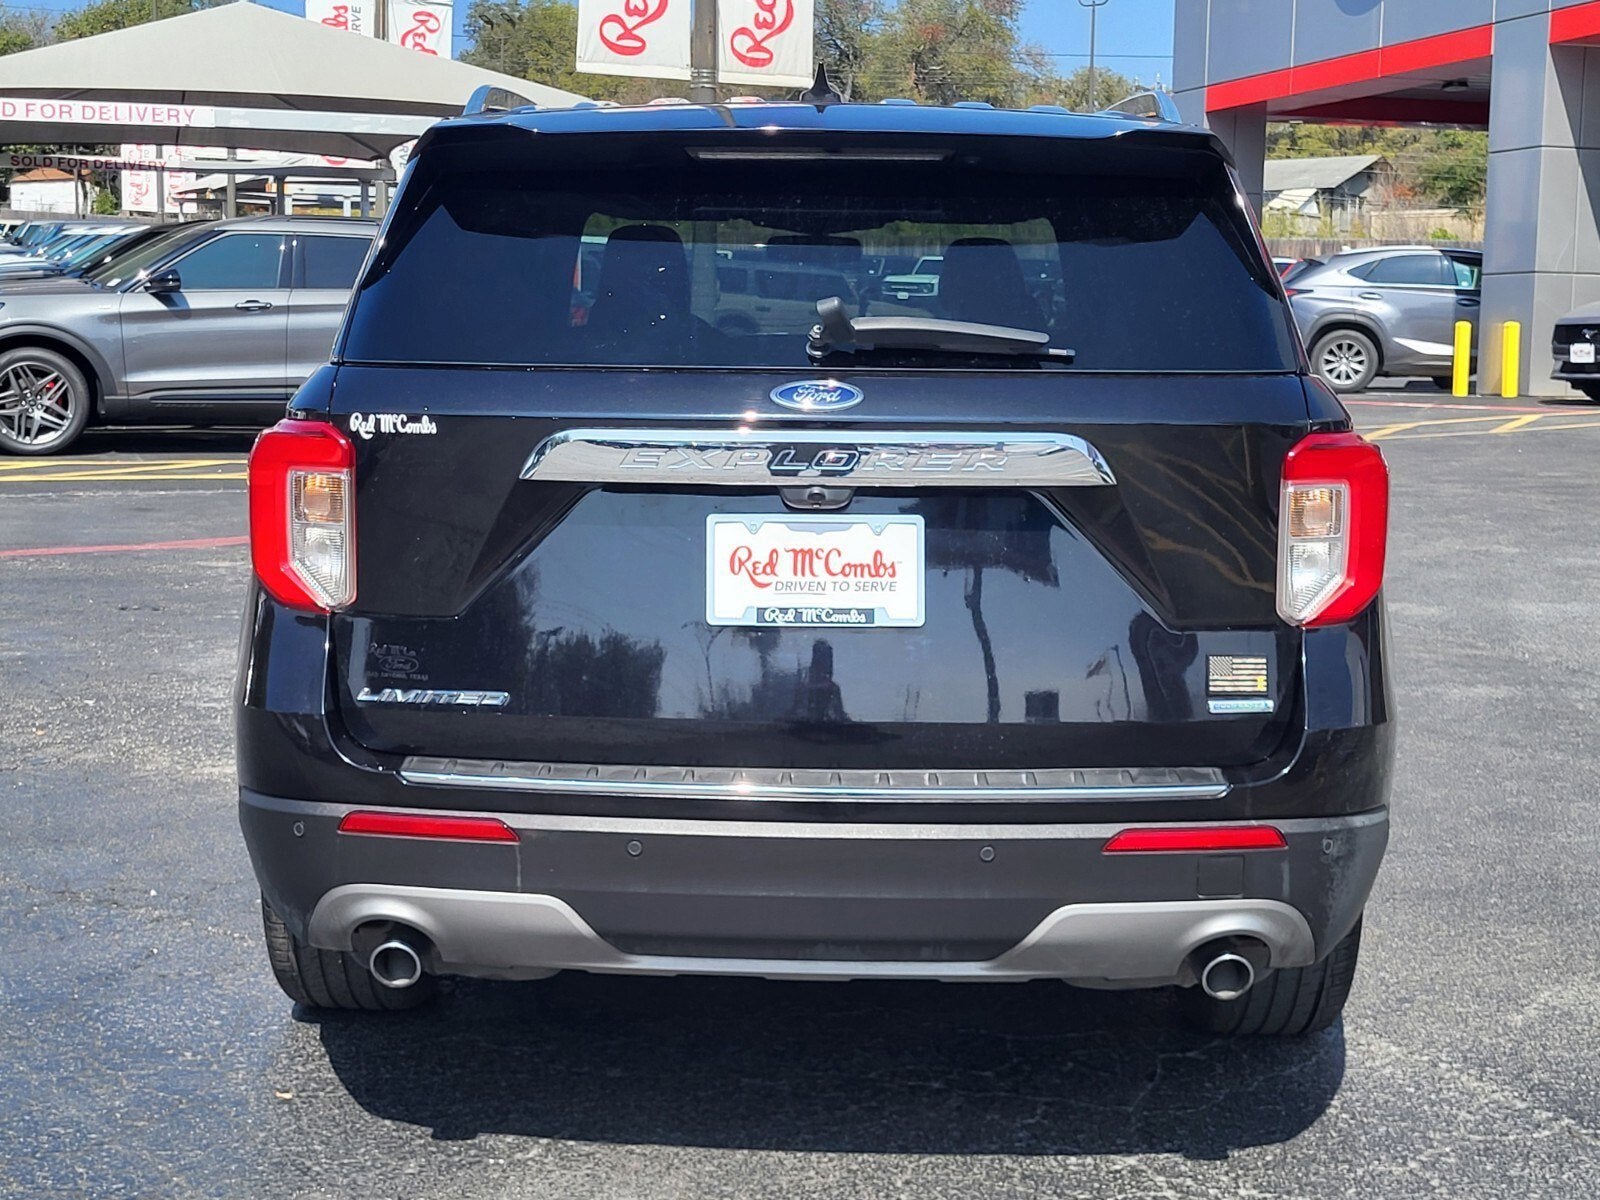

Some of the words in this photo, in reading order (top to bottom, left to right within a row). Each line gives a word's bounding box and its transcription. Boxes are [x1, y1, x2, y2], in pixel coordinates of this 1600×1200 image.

[351, 5, 362, 32] RVE
[731, 0, 794, 68] Re
[25, 102, 73, 119] FOR
[82, 105, 196, 124] DELIVERY
[10, 155, 53, 168] SOLD
[57, 158, 89, 169] FOR
[94, 159, 167, 171] DELIVERY
[792, 384, 842, 403] Ford
[349, 412, 376, 440] Red
[376, 413, 438, 434] McCombs
[619, 447, 1010, 473] EXPLORER
[729, 545, 779, 588] Red
[784, 547, 898, 579] McCombs
[774, 580, 827, 593] DRIVEN
[832, 581, 850, 592] TO
[854, 581, 898, 592] SERVE
[764, 608, 796, 625] Red
[799, 608, 867, 624] McCombs
[356, 687, 511, 707] LIMITED
